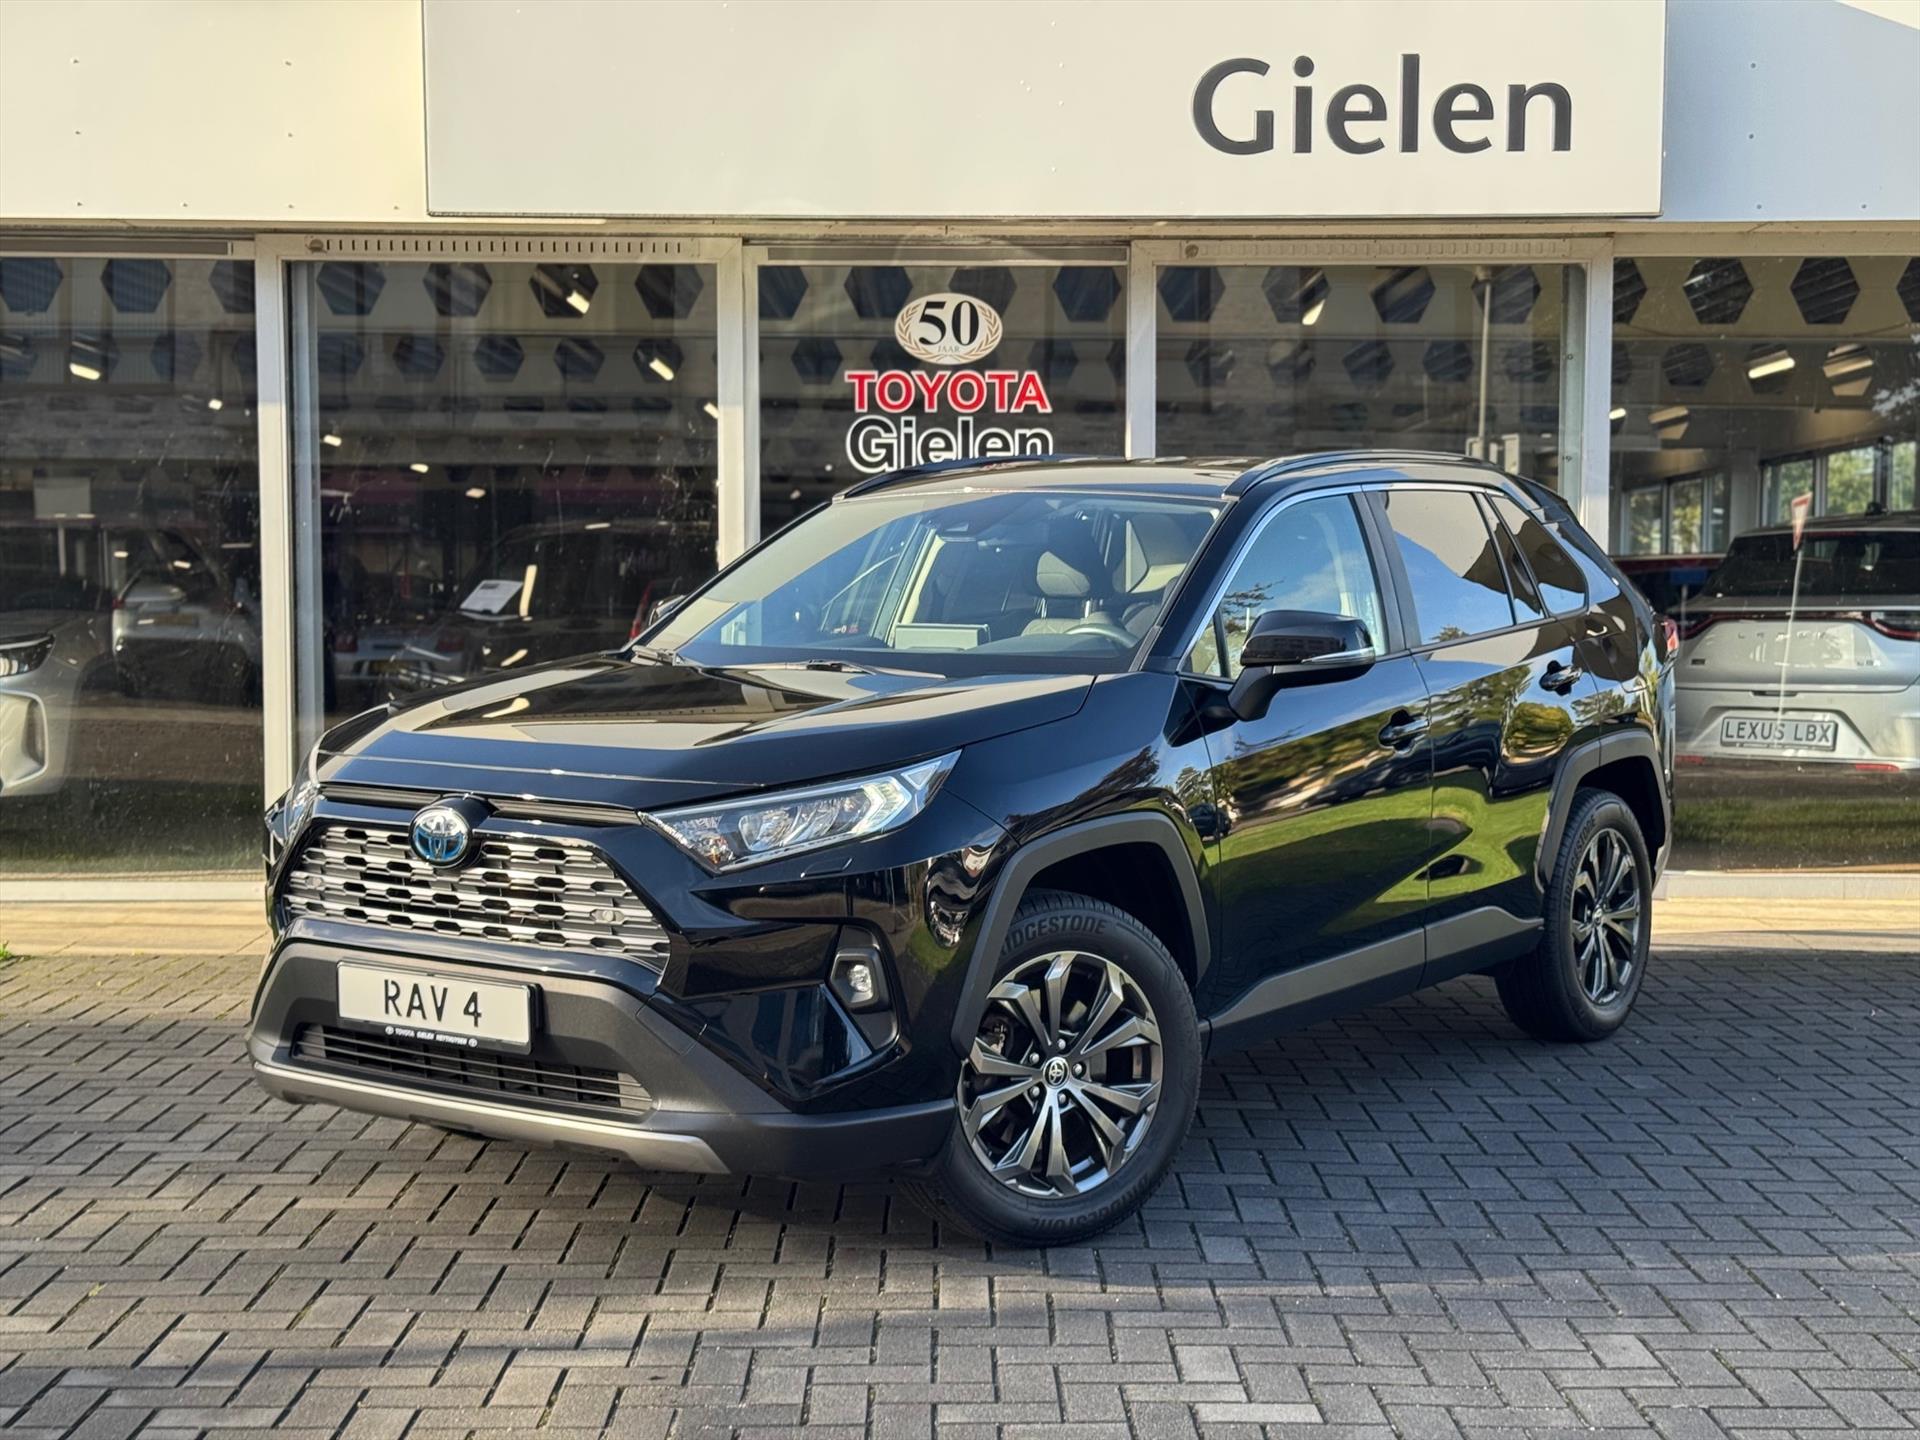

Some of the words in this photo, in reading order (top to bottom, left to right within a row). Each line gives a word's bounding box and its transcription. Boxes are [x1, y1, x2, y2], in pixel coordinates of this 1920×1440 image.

[1192, 53, 1572, 155] Gielen
[919, 300, 980, 346] 50
[845, 370, 1052, 413] TOYOTA
[845, 415, 1054, 473] Gielen
[1724, 721, 1786, 741] LEXUS
[1793, 723, 1832, 743] LBX
[1001, 914, 1107, 956] IDGESTONE
[384, 979, 449, 1022] RAV
[463, 991, 482, 1028] 4
